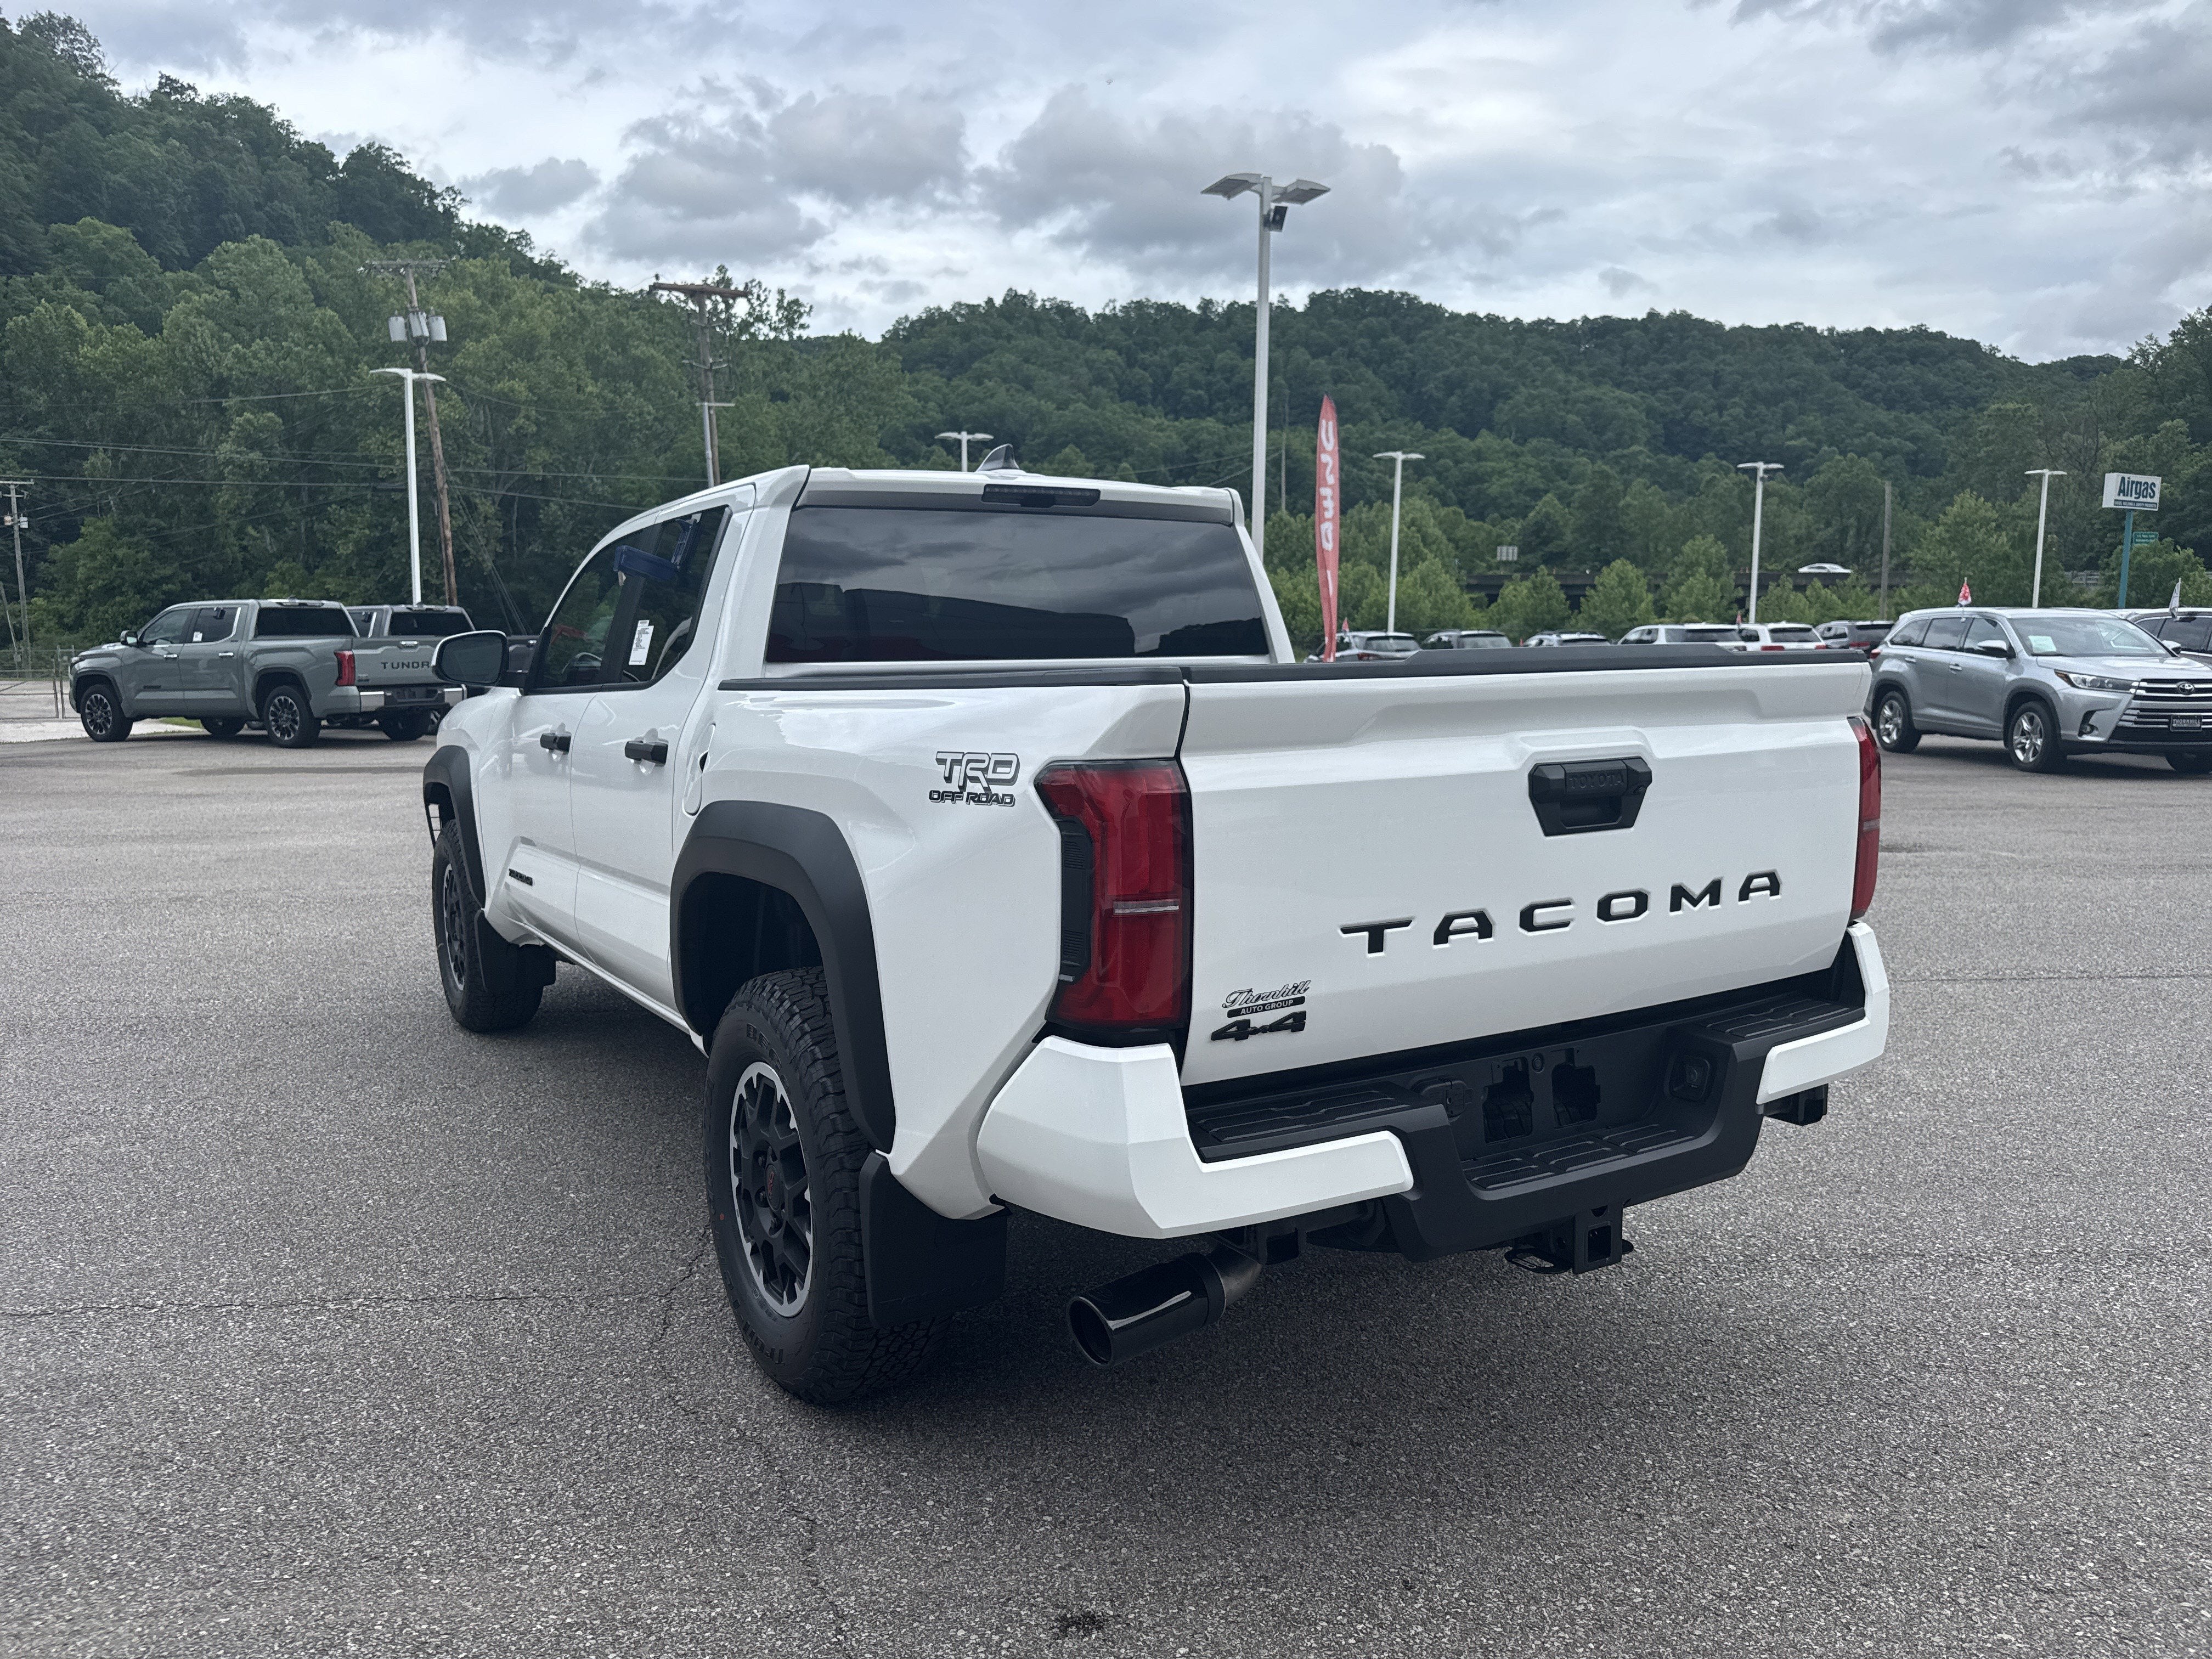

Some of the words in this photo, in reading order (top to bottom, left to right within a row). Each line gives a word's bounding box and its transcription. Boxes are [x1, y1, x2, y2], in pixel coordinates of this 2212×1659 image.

[2117, 476, 2156, 499] Airgas
[380, 661, 431, 670] TUNDR
[935, 751, 1020, 793] TRD
[1569, 770, 1624, 789] TOYOTA
[929, 790, 964, 804] OFF
[966, 792, 1015, 807] ROAD
[1340, 871, 1782, 955] TACOMA
[1222, 980, 1311, 1008] Thornhill
[1240, 1005, 1263, 1015] AUTO
[1265, 1000, 1294, 1011] GROUP
